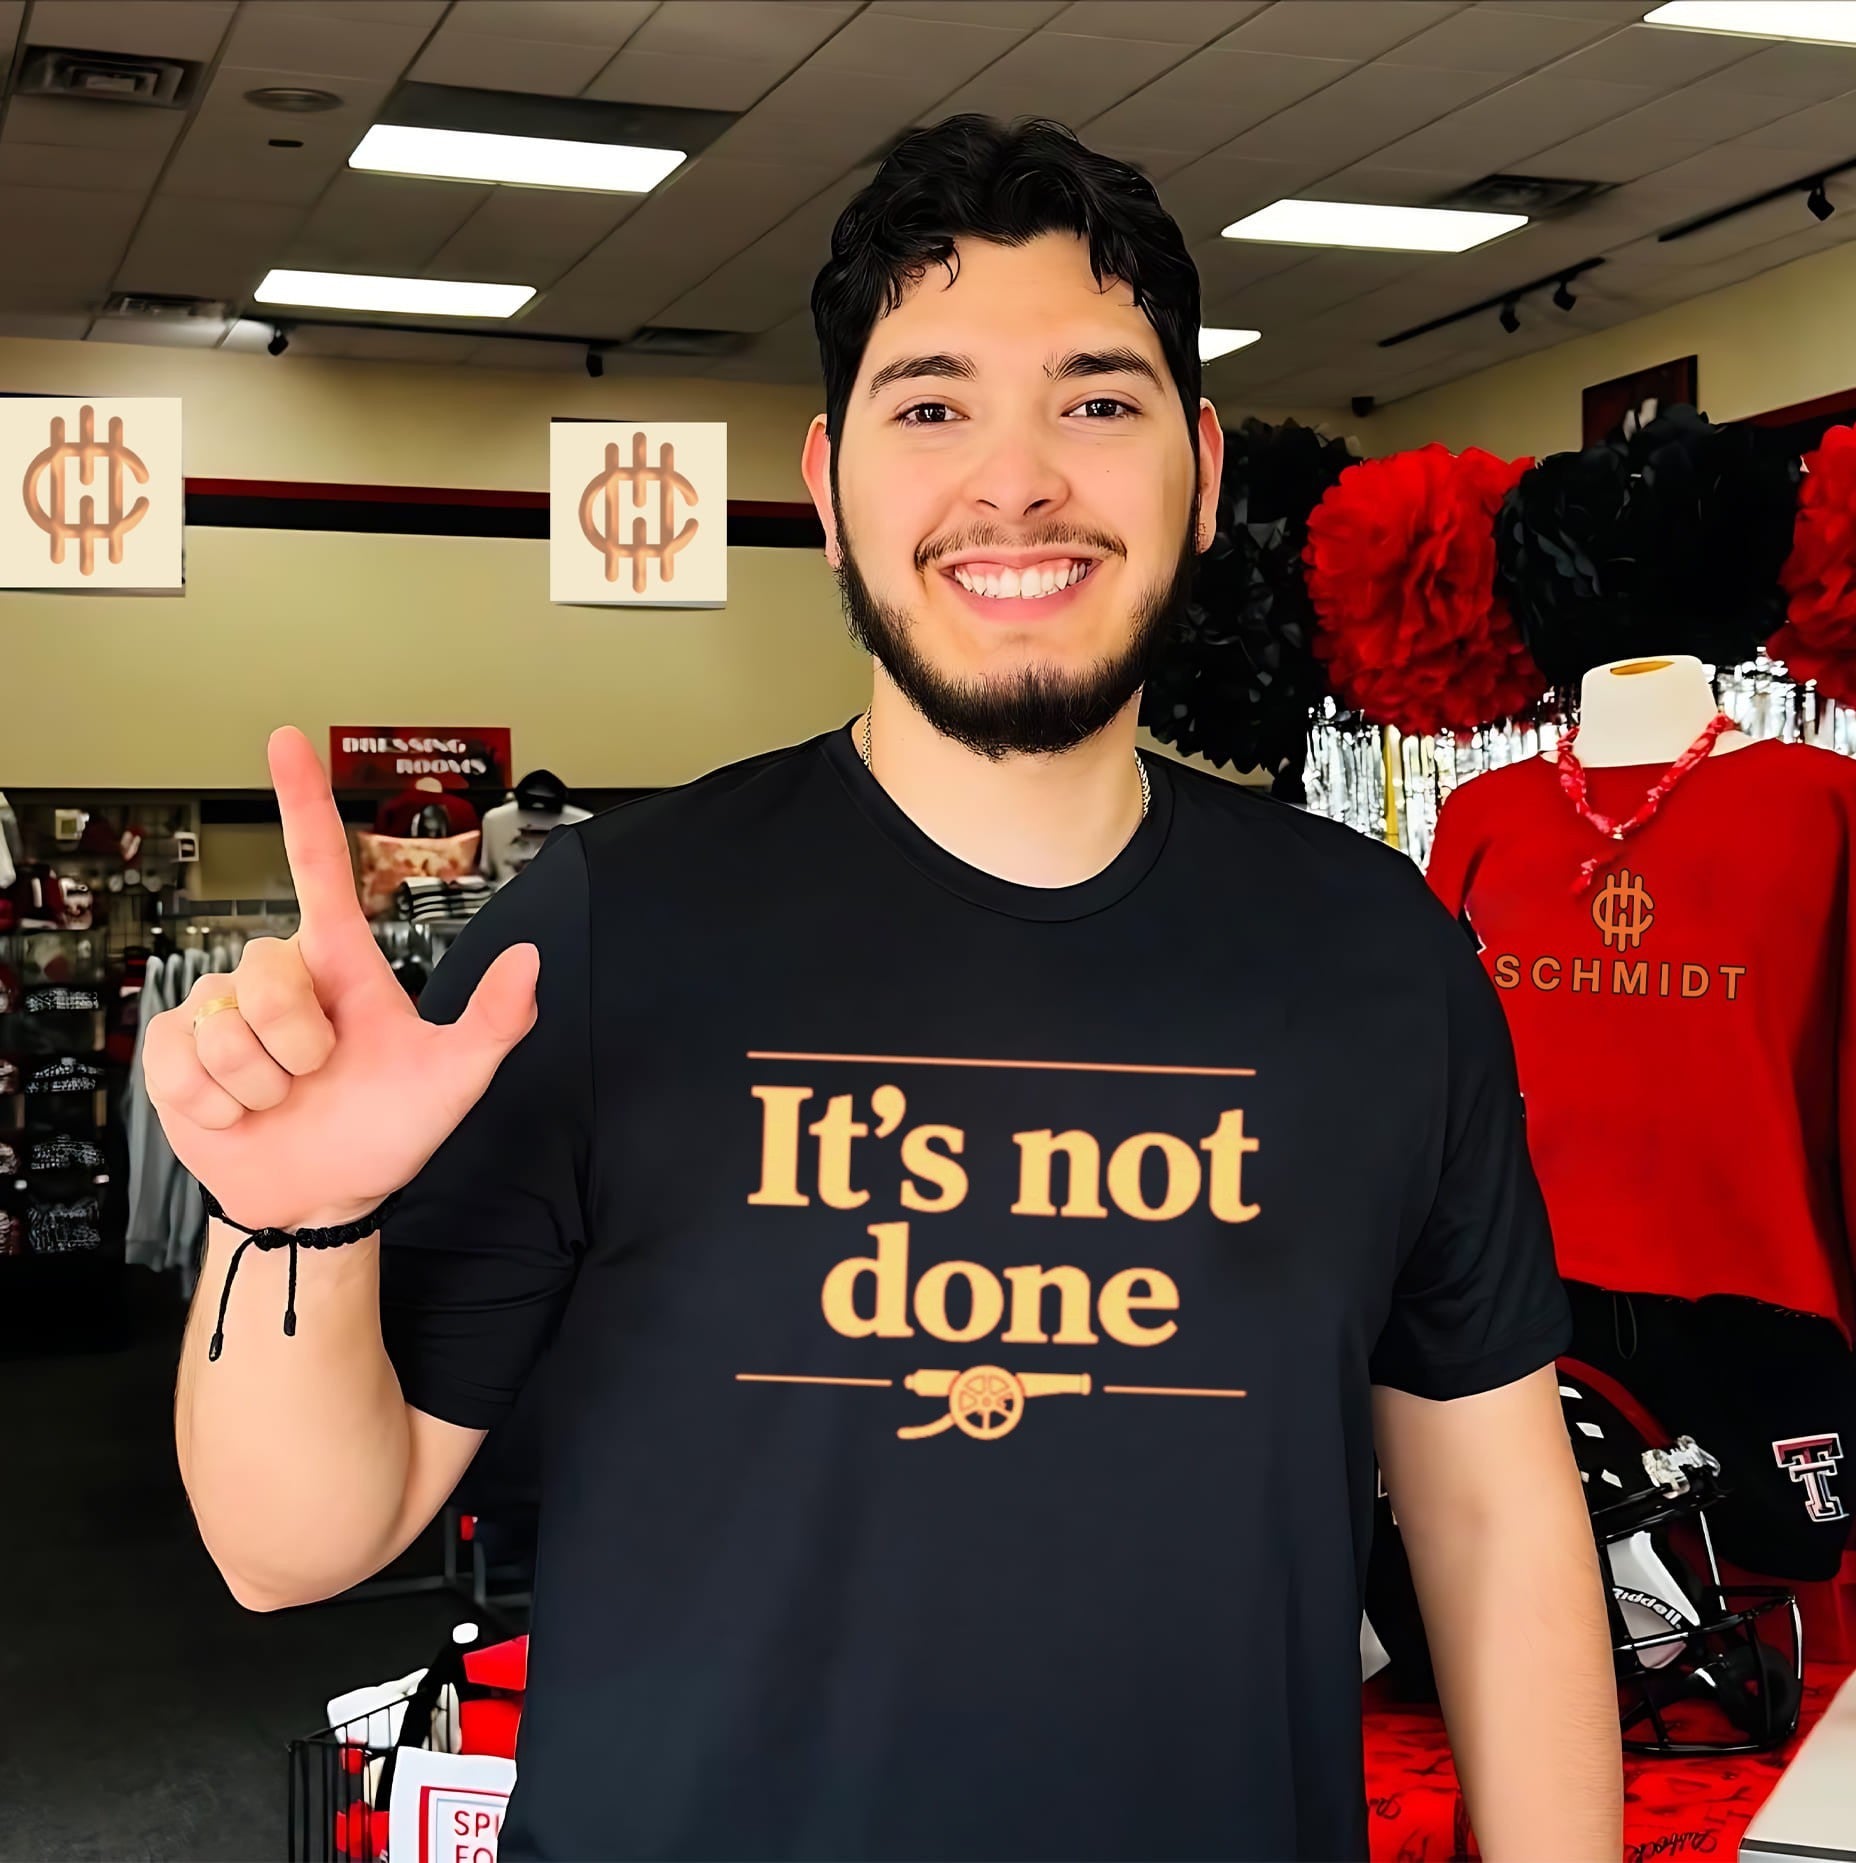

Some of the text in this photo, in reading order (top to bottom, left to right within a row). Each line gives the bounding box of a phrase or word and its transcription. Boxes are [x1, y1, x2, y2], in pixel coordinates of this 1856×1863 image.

[341, 736, 467, 754] DRESSING
[395, 758, 487, 775] ROOMS
[1493, 953, 1748, 1000] SCHMIDT
[747, 1084, 1261, 1224] It's not
[820, 1220, 1180, 1348] done
